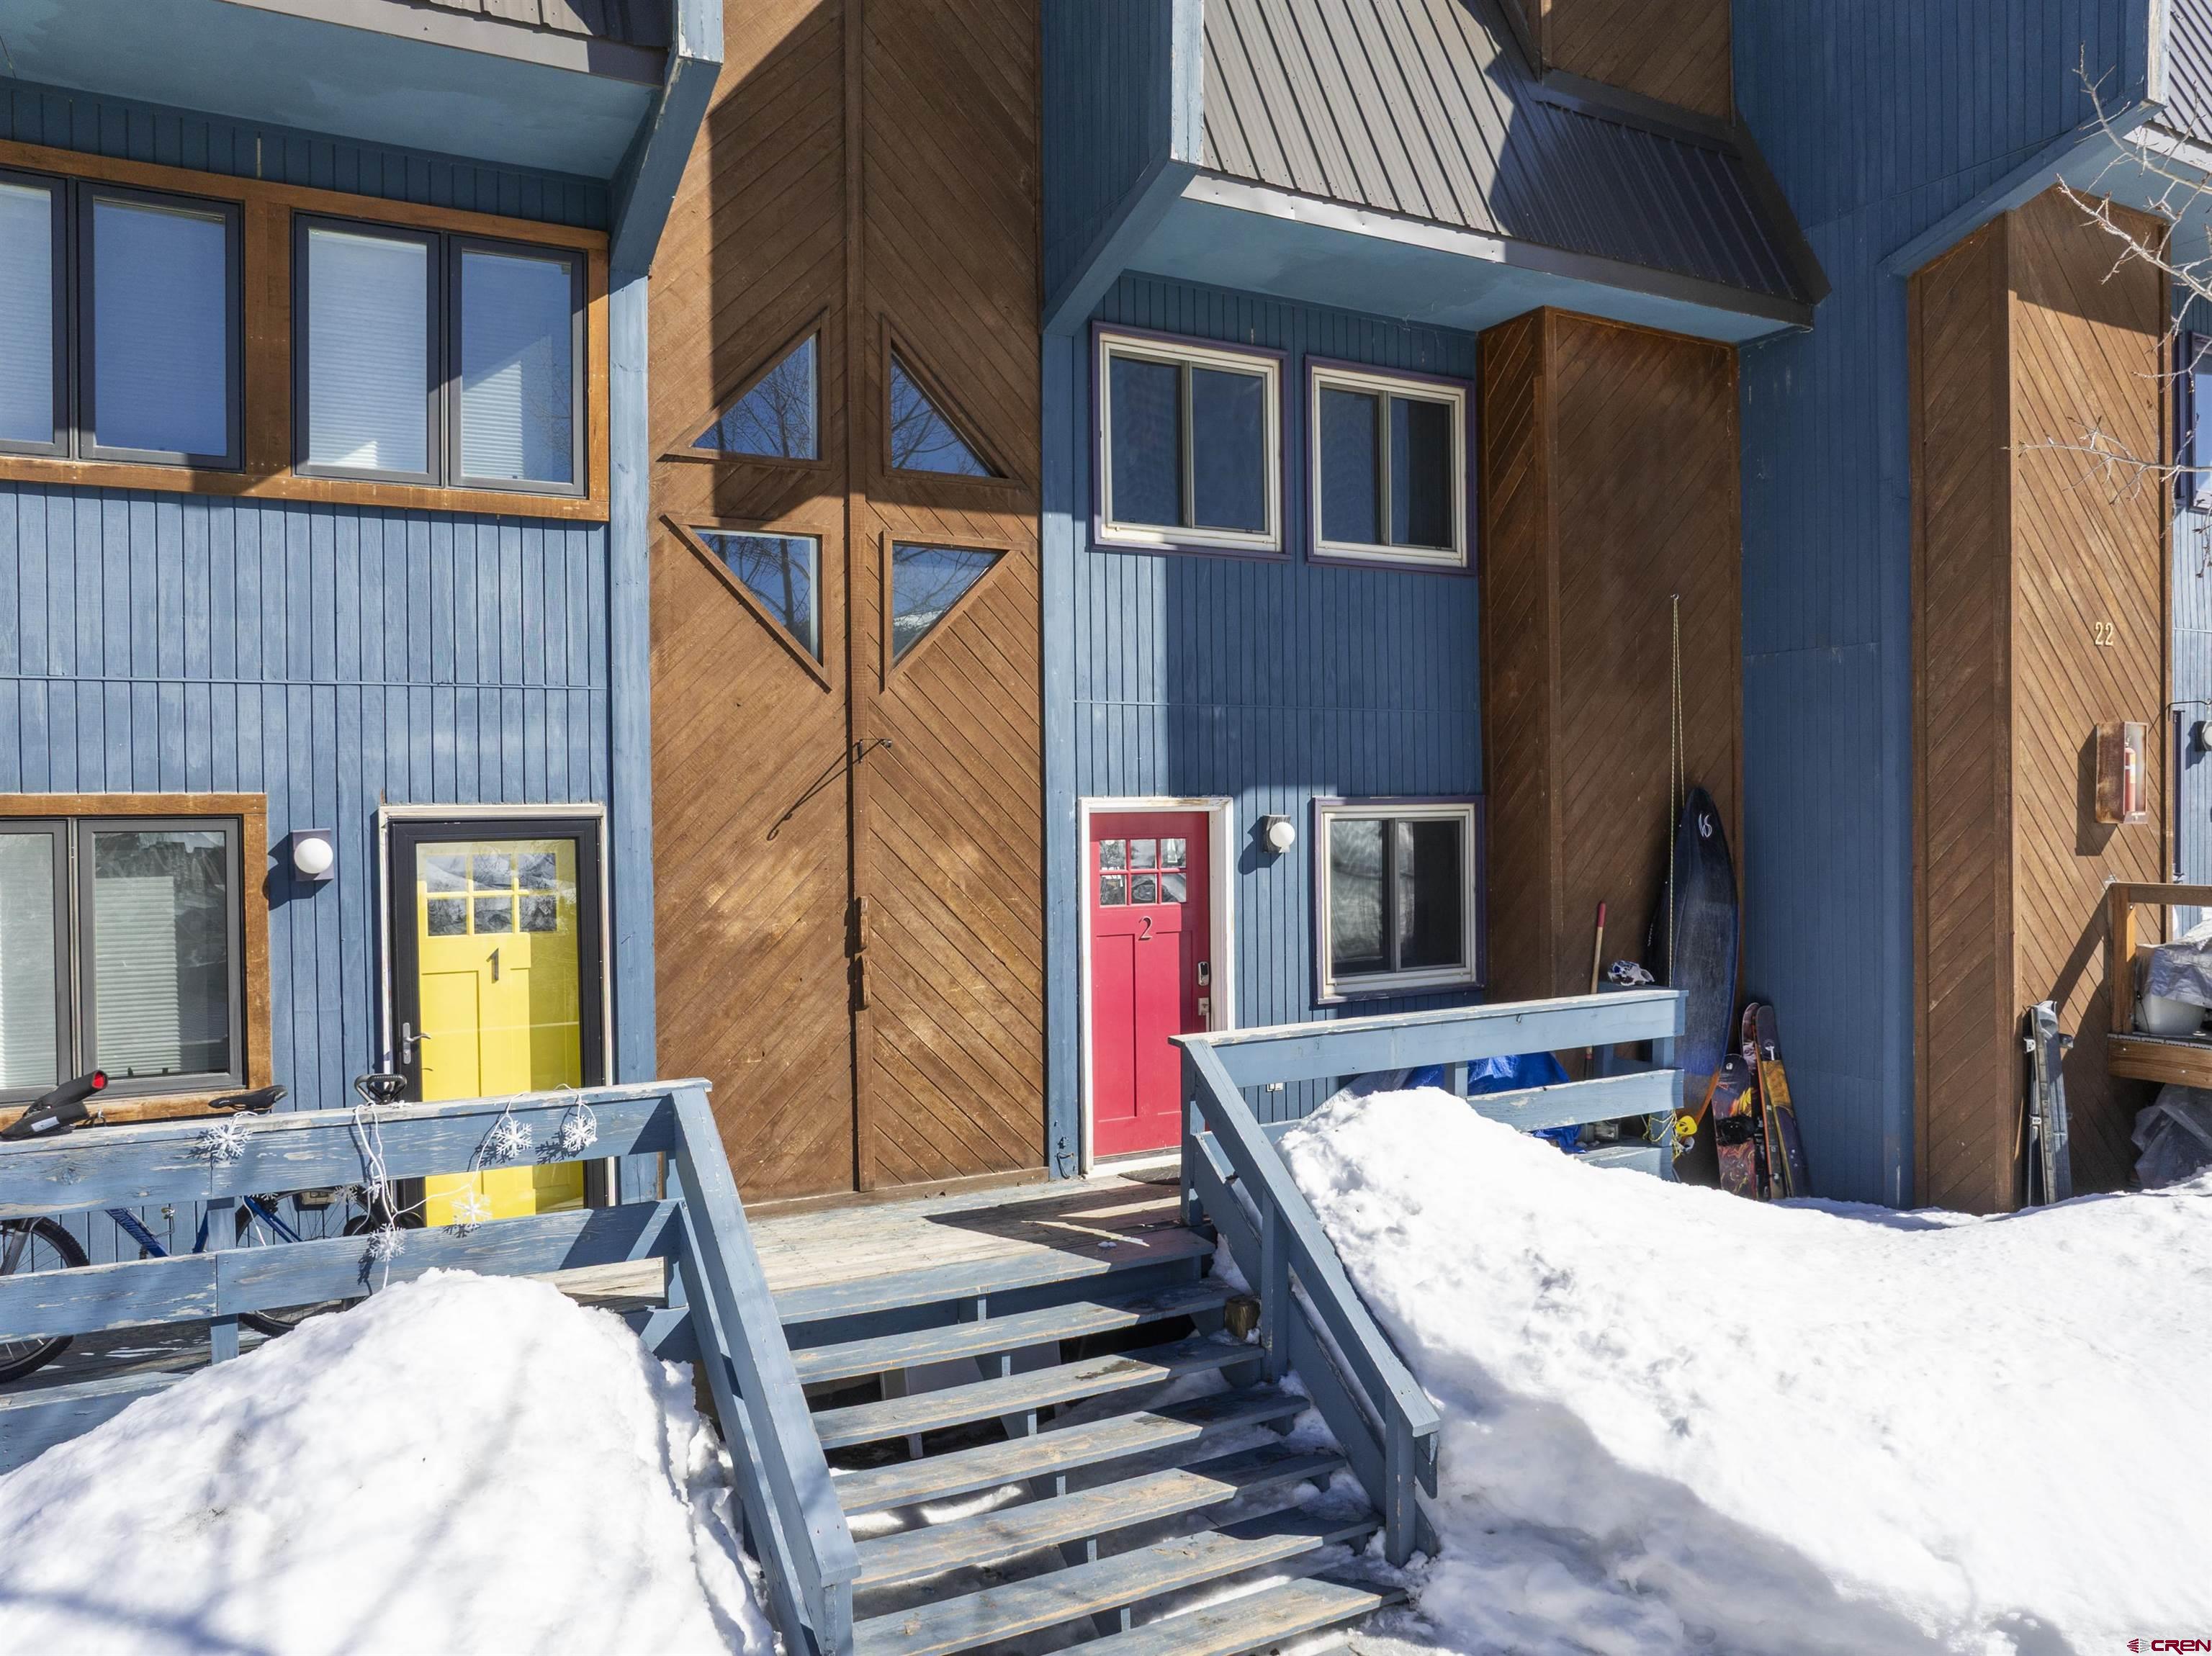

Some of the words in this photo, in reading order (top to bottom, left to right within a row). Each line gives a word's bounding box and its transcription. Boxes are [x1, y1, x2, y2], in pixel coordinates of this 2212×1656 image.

[2095, 621, 2114, 647] 22
[1138, 915, 1153, 941] 2
[485, 948, 500, 984] 1
